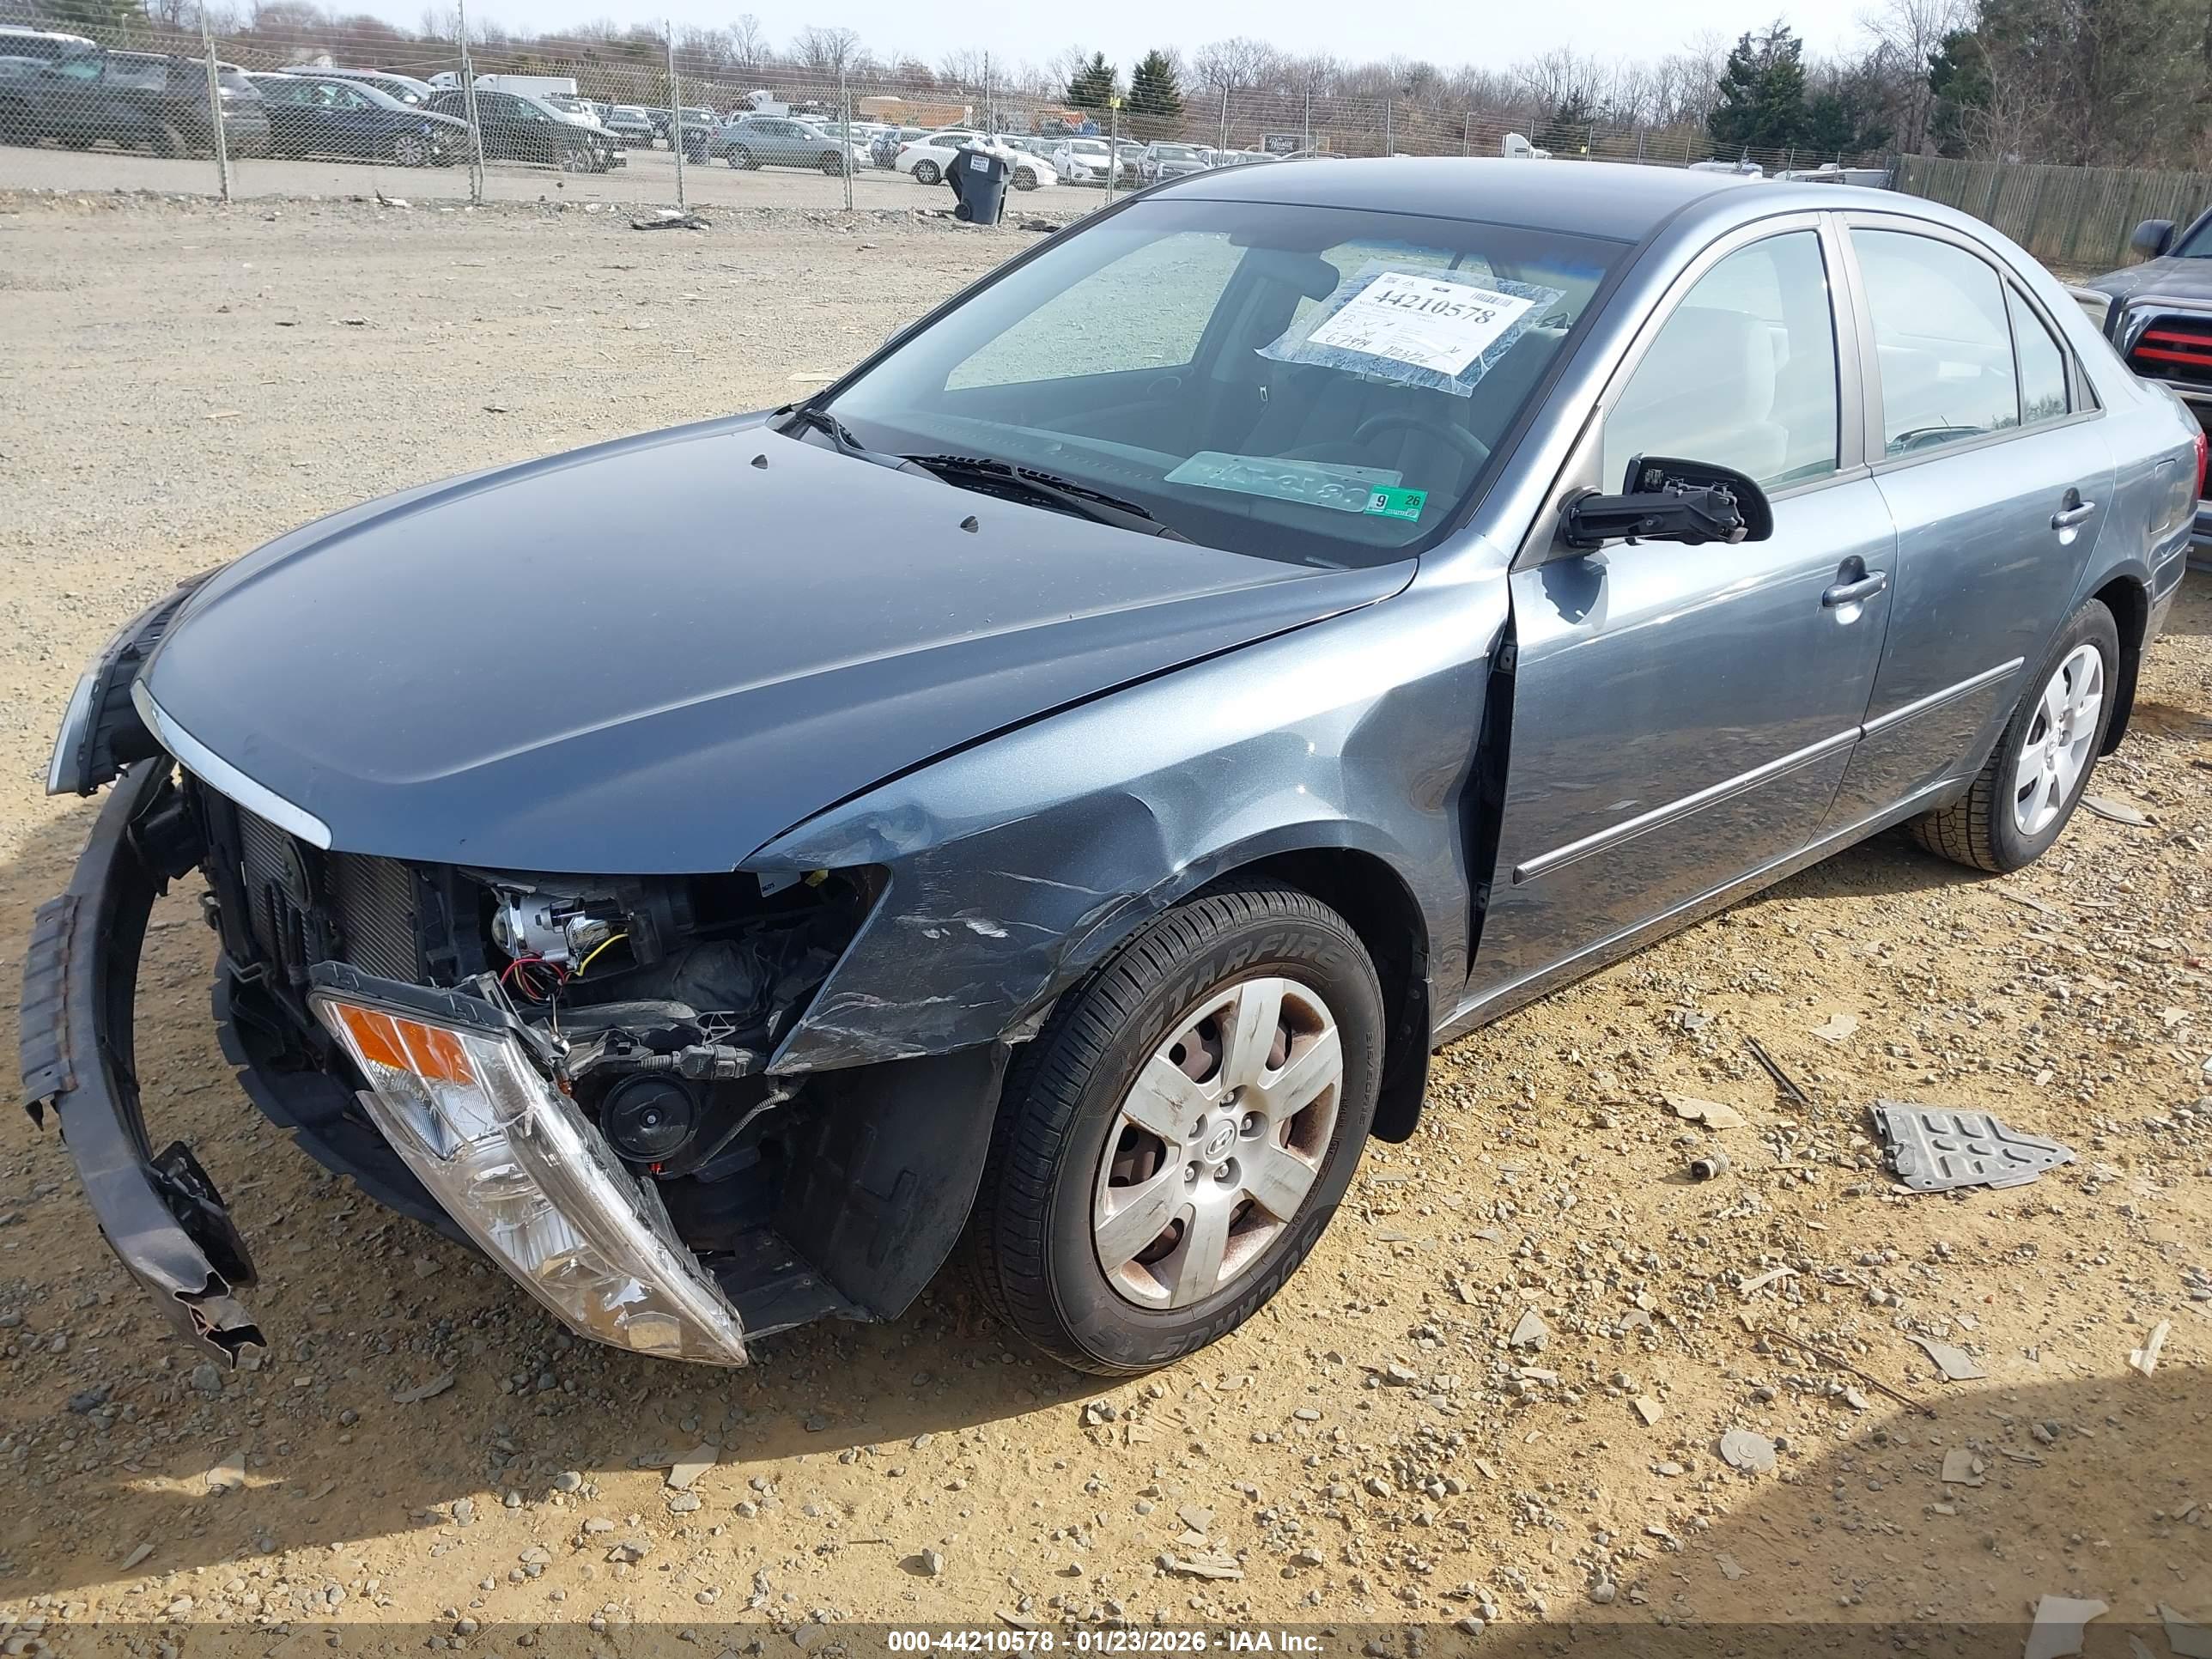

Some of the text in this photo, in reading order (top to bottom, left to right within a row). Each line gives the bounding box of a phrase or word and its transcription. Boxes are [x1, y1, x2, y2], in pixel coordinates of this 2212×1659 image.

[1374, 290, 1497, 325] 44210578
[1376, 495, 1421, 507] 9 26
[1139, 933, 1347, 1046] STARFIRE
[1149, 1218, 1320, 1361] SOLARUS
